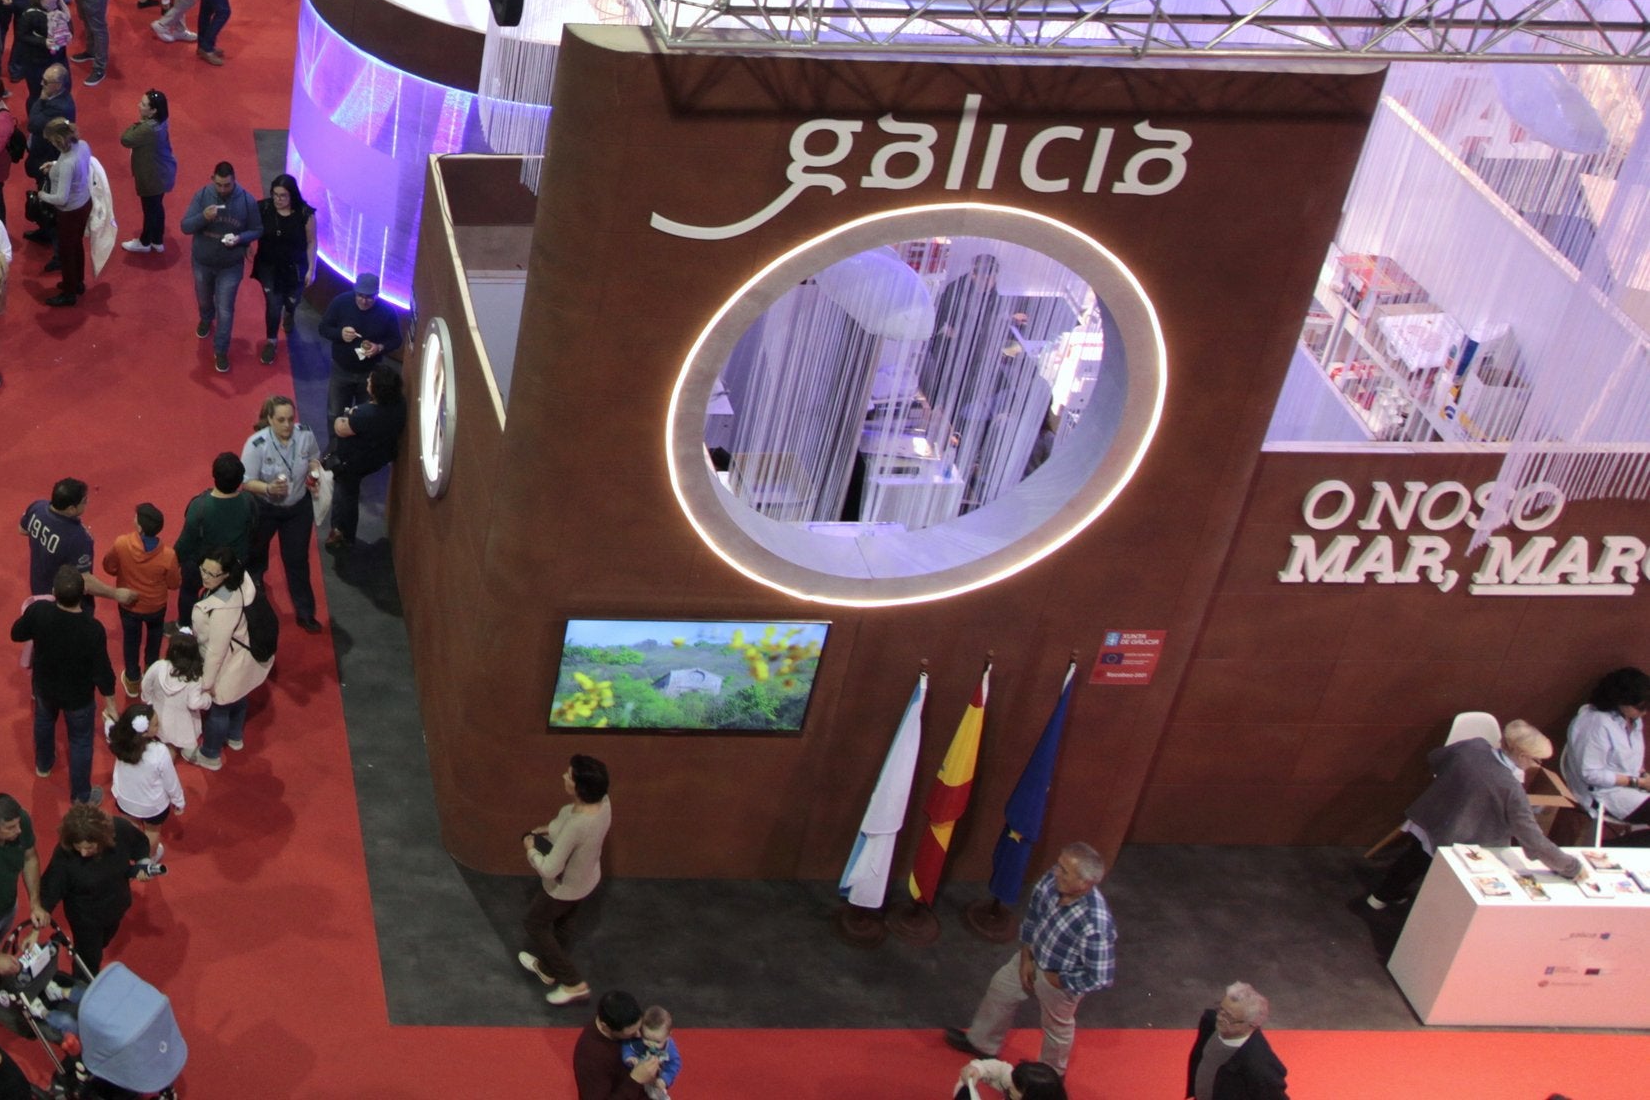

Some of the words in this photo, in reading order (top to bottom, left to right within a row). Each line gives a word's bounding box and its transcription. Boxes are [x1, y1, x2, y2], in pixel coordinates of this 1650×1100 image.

[650, 93, 1193, 241] galicia
[1302, 479, 1356, 531] O
[27, 513, 61, 554] 1950
[1277, 534, 1460, 593] MAR,
